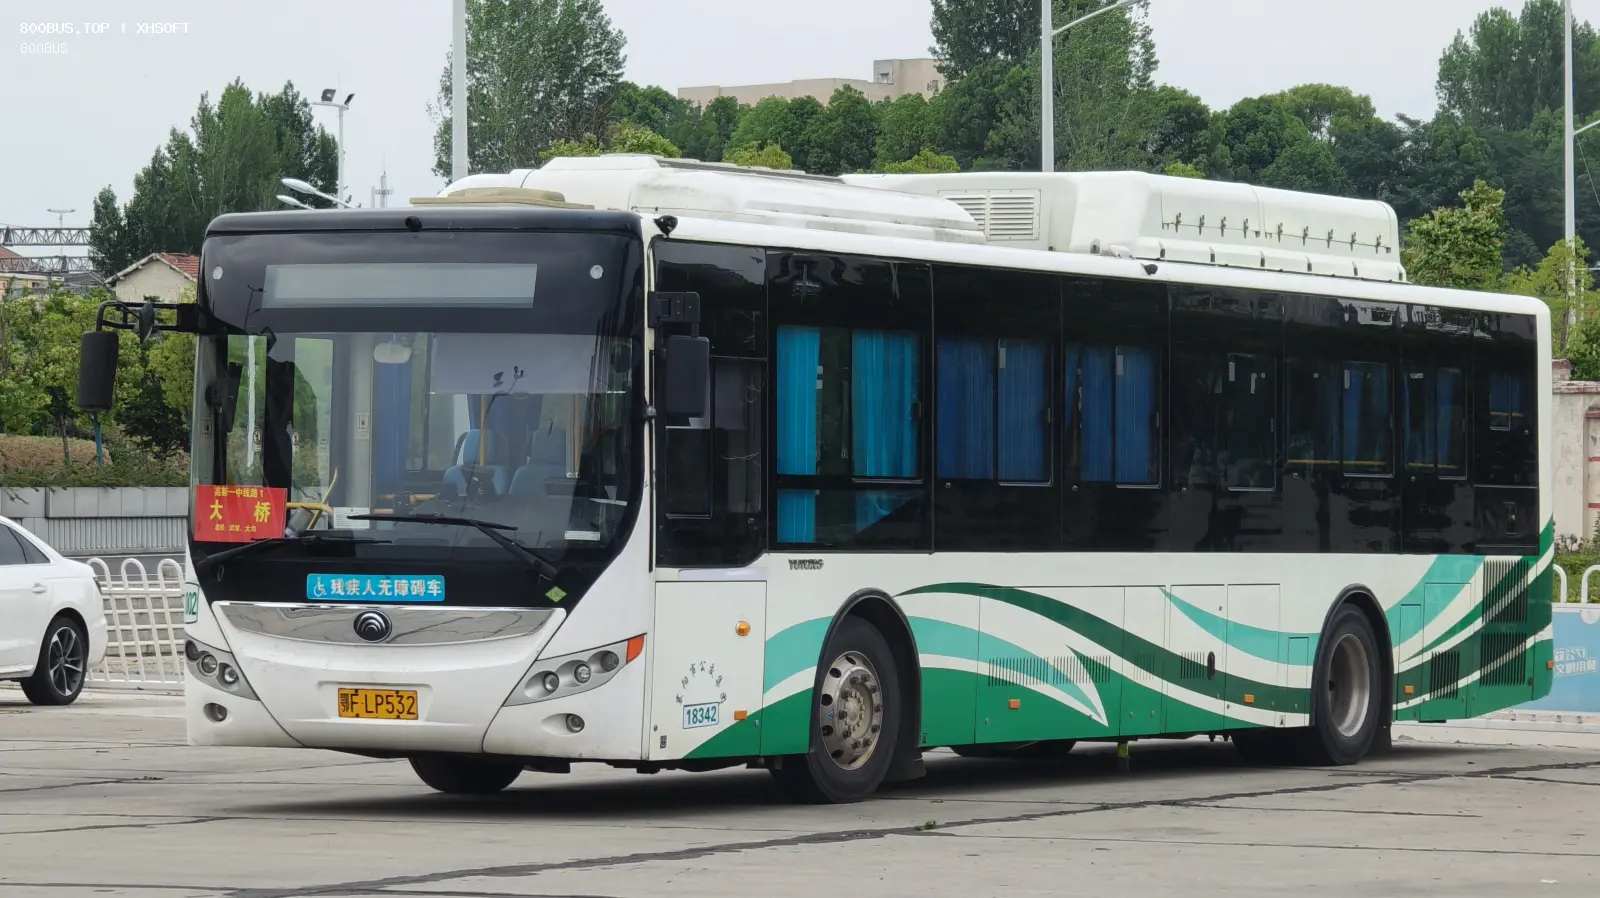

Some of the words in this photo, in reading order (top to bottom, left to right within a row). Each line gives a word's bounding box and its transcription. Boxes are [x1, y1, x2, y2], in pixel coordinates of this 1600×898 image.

[330, 579, 442, 597] 残疾人无障碍车
[686, 705, 717, 725] 18342
